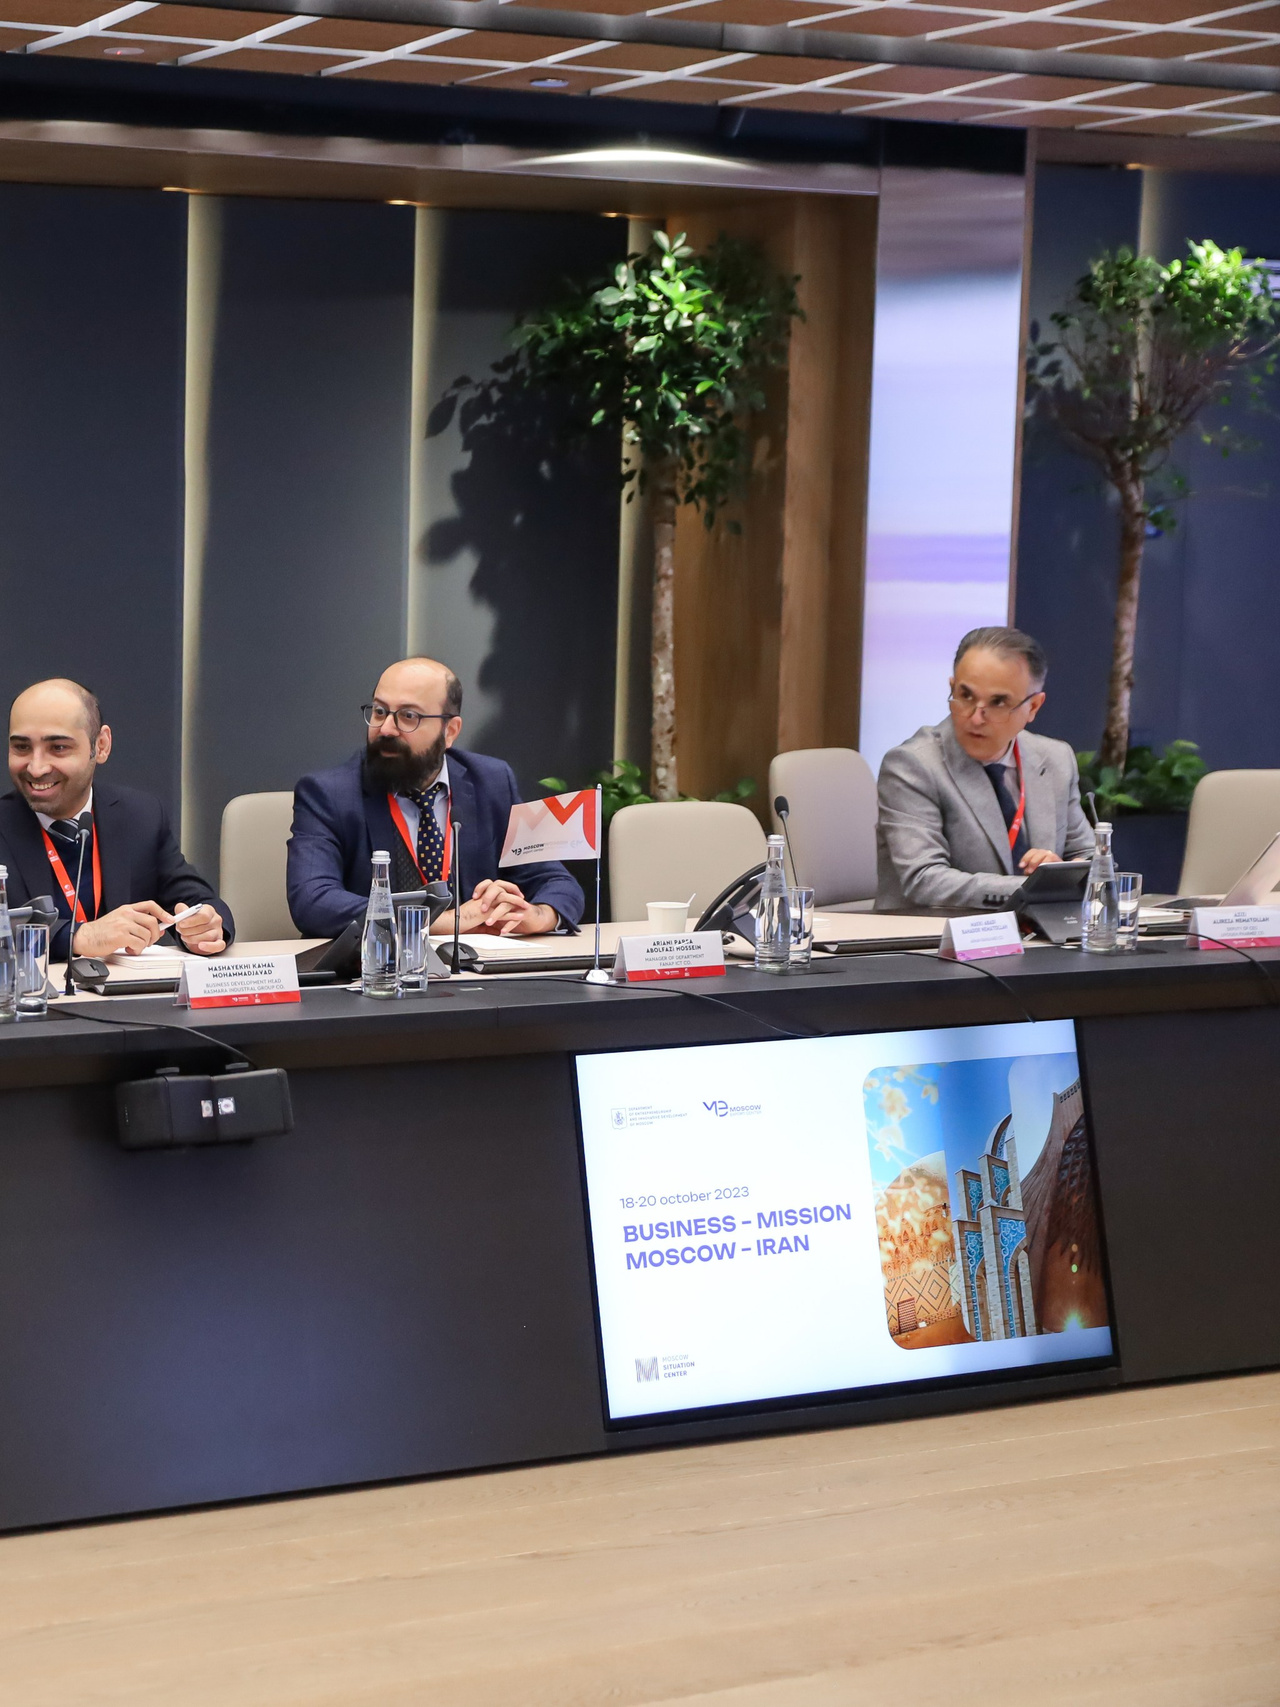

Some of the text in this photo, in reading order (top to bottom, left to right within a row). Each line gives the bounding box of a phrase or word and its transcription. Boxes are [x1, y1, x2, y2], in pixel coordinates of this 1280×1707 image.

[208, 964, 250, 972] MASHAYEKHI
[213, 970, 272, 978] MOHAMMADJAVAD
[660, 1190, 711, 1205] october
[714, 1186, 750, 1200] 2023
[623, 1215, 736, 1242] BUSINESS
[757, 1204, 852, 1229] MISSION
[626, 1242, 736, 1270] MOSCOW
[756, 1235, 810, 1256] IRAN
[662, 1354, 689, 1362] MOSCOW
[663, 1361, 695, 1370] SITUATION
